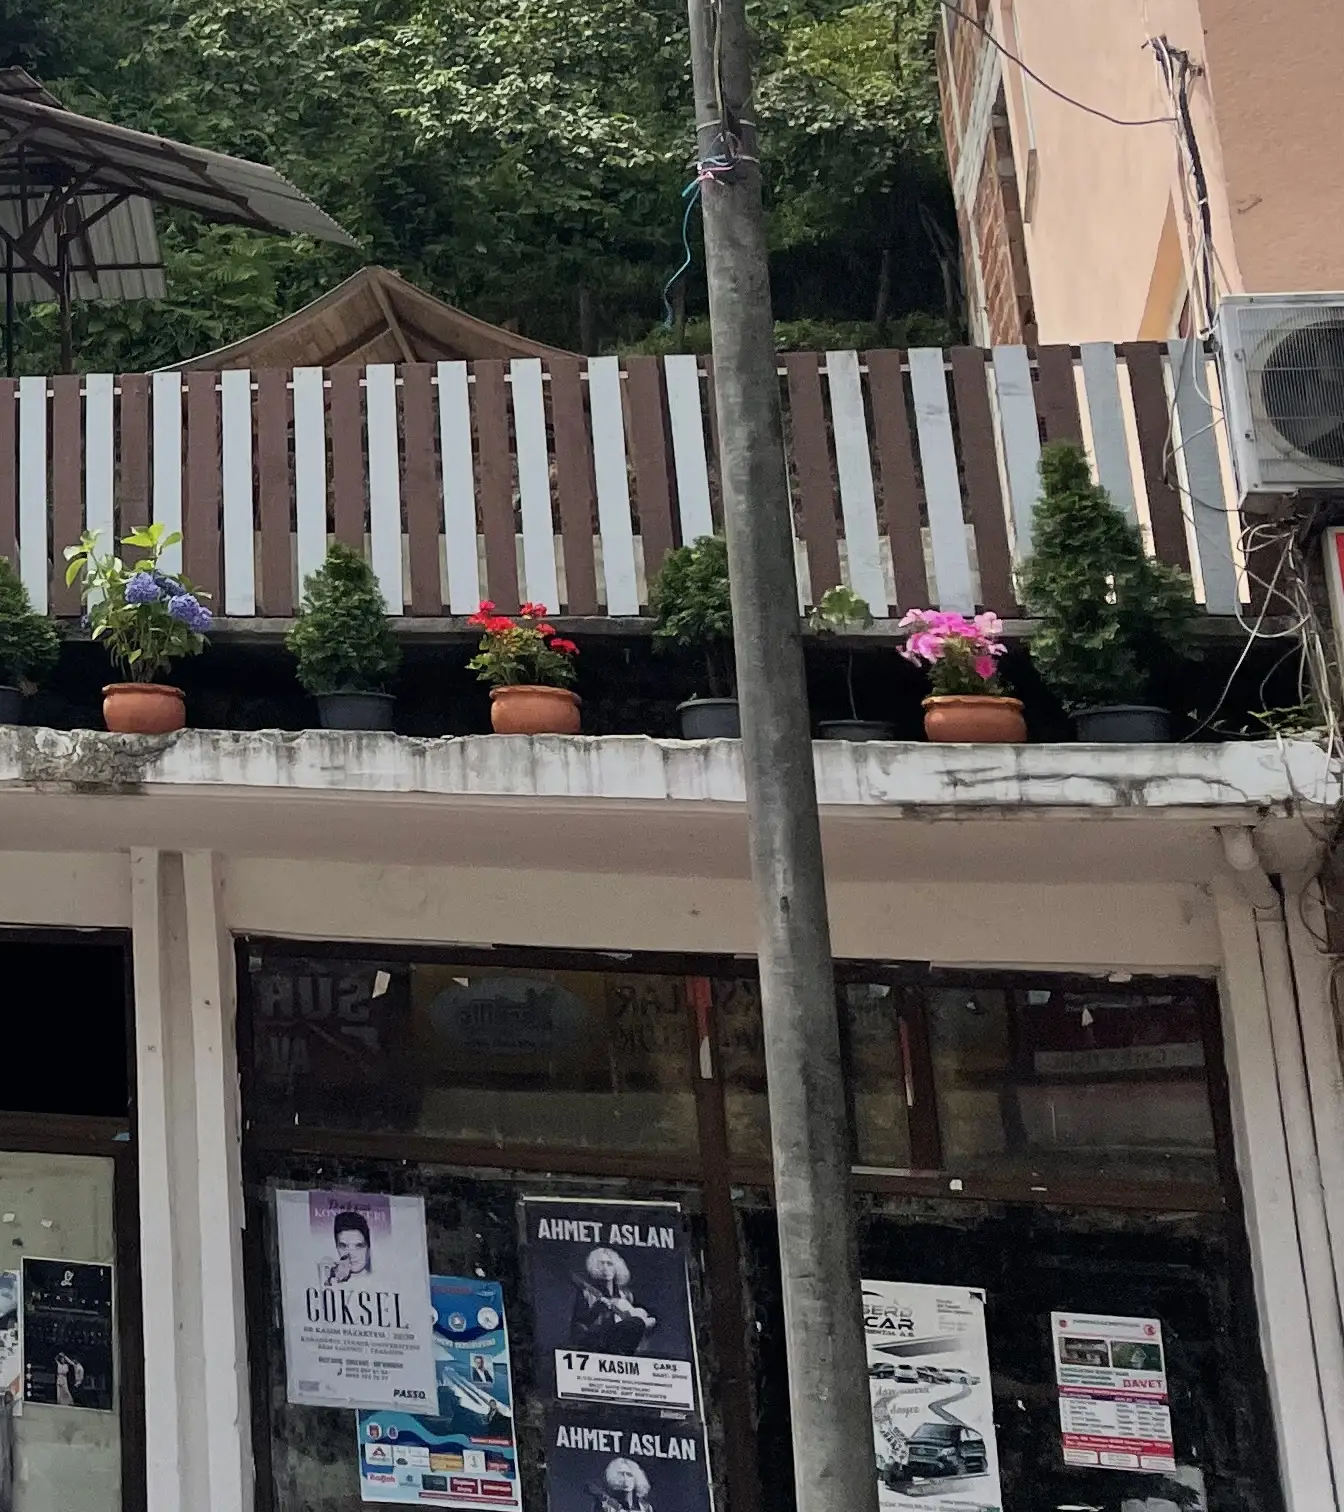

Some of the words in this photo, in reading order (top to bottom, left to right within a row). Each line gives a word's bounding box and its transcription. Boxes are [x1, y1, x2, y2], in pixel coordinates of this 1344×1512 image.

[538, 1218, 603, 1243] AHMET
[609, 1224, 675, 1249] ASLAN
[864, 1316, 915, 1331] CAR
[562, 1352, 590, 1371] 17
[598, 1359, 640, 1376] KASIM
[1122, 1379, 1163, 1389] DAVET
[556, 1424, 623, 1453] AHMET
[629, 1432, 696, 1461] ASLAN
